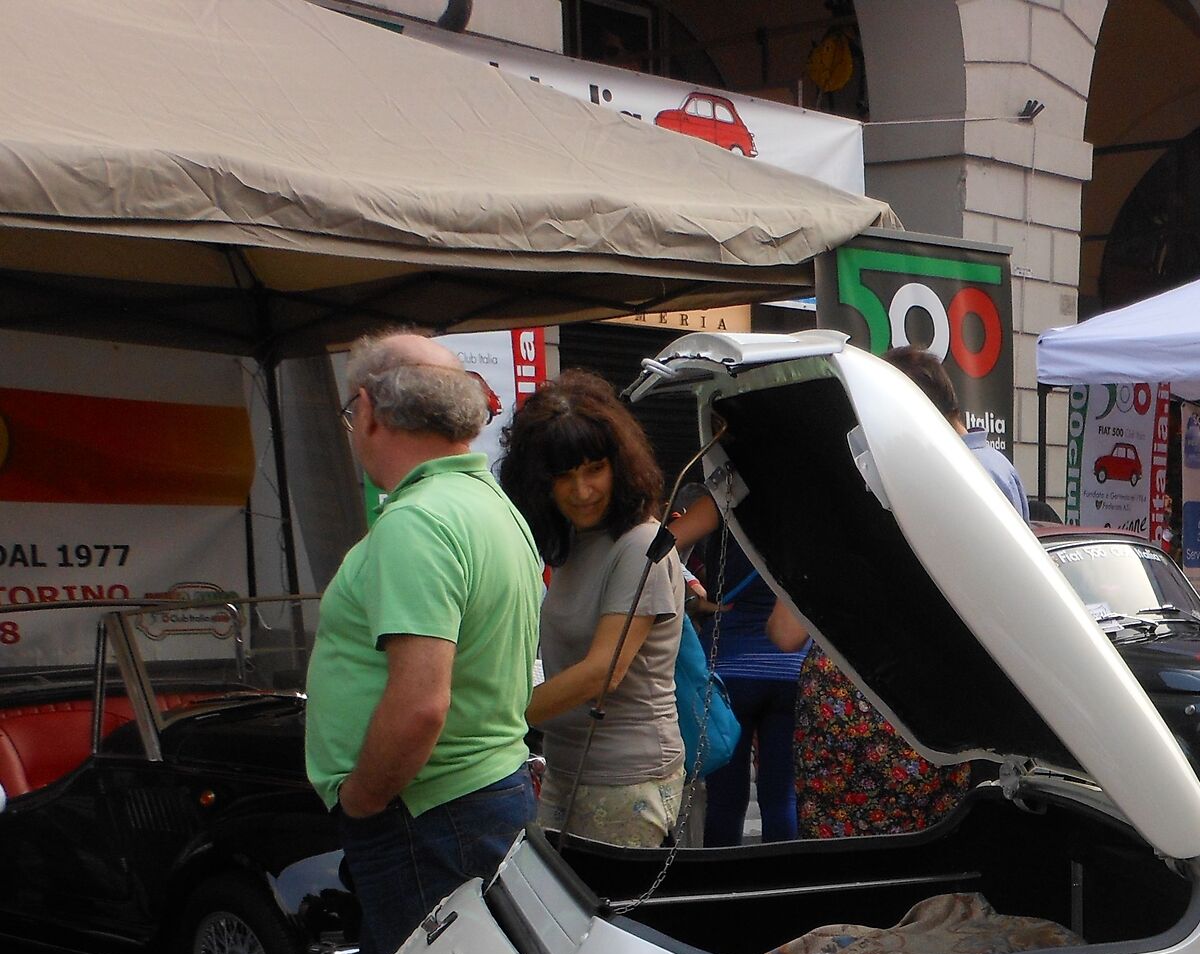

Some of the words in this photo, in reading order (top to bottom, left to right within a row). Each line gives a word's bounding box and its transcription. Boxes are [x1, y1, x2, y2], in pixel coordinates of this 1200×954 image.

[837, 247, 1003, 379] 500
[965, 411, 1006, 434] Italia
[1098, 425, 1111, 435] FIAT
[1111, 427, 1124, 438] 500
[57, 544, 130, 568] 1977
[0, 584, 130, 607] ORINO
